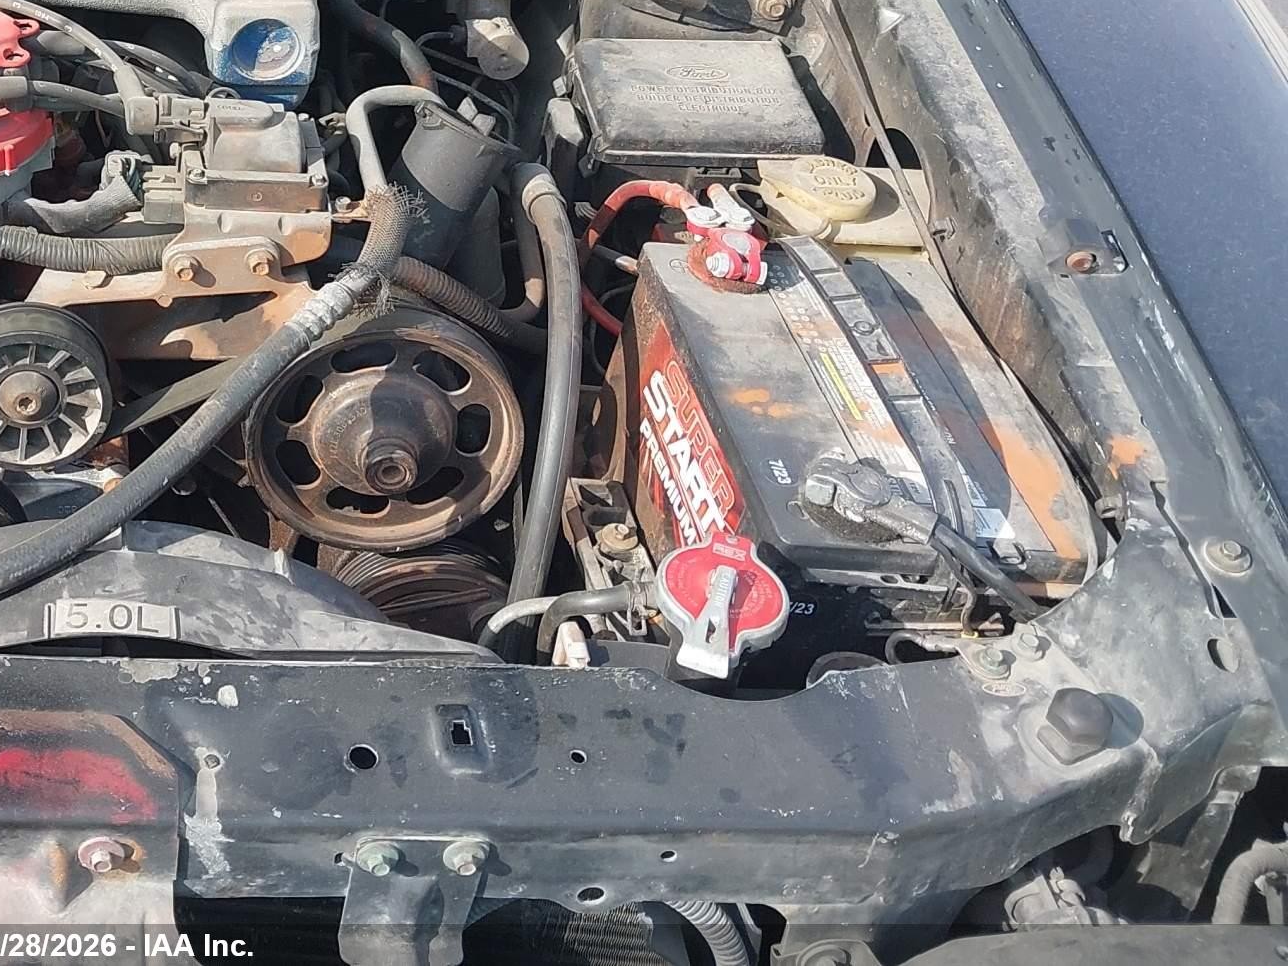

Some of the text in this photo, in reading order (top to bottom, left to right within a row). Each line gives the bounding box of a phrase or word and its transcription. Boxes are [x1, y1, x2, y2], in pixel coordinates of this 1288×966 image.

[679, 66, 721, 79] Ford
[643, 370, 725, 532] START
[665, 360, 735, 517] SUPER
[640, 417, 697, 546] PREMIUM
[768, 459, 793, 485] 7/23
[64, 600, 161, 634] 5.0L
[788, 601, 815, 615] /23
